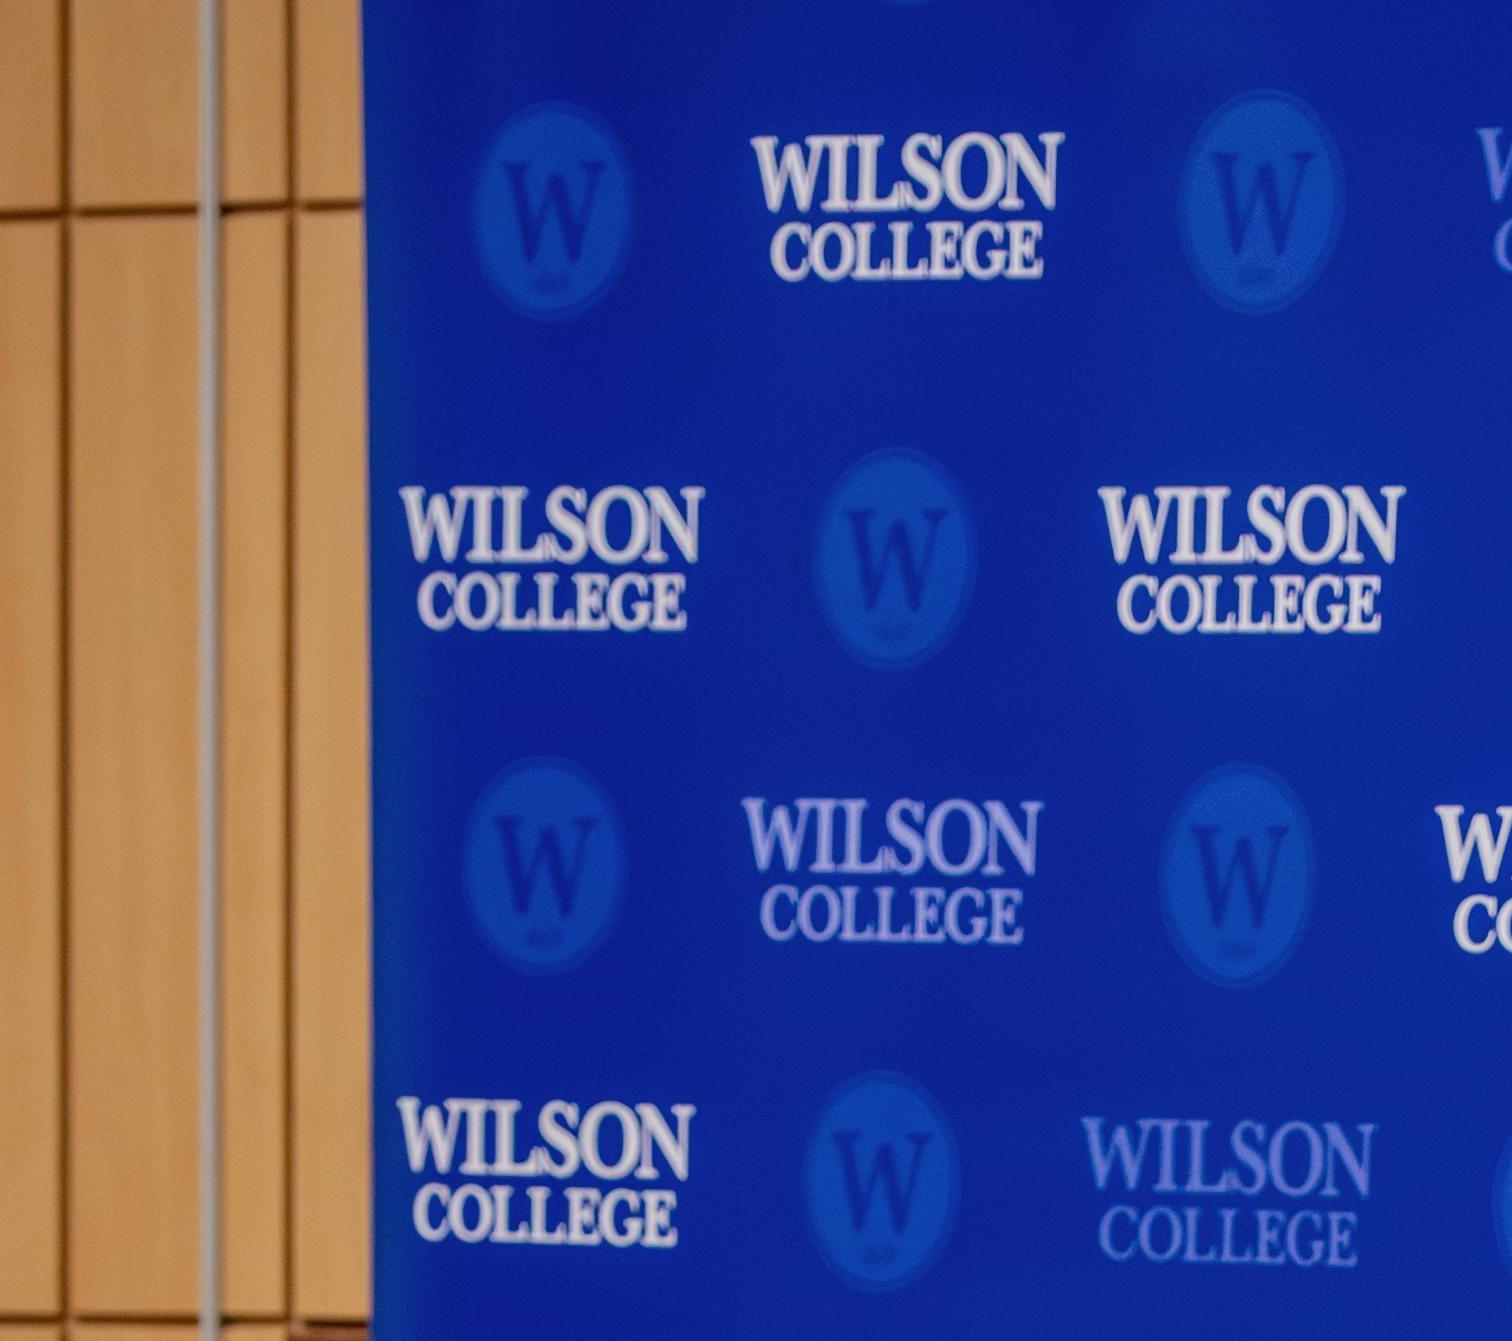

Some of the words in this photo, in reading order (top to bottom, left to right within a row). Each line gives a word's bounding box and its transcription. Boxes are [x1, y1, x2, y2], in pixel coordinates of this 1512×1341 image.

[505, 160, 606, 262] W
[752, 133, 1064, 211] WILSON
[1210, 150, 1316, 258] W
[771, 221, 1043, 281] COLLEGE
[401, 486, 704, 563] WILSON
[842, 509, 948, 613] W
[1098, 485, 1405, 564] WILSON
[418, 572, 686, 630] COLLEGE
[1118, 575, 1381, 633] COLLEGE
[492, 816, 598, 917] W
[743, 798, 1042, 875] WILSON
[761, 885, 1022, 944] COLLEGE
[1191, 826, 1288, 927] W
[397, 1097, 694, 1179] WILSON
[1082, 1117, 1374, 1196] WILSON
[414, 1183, 677, 1247] COLLEGE
[833, 1131, 931, 1234] W
[1100, 1206, 1357, 1267] COLLEGE
